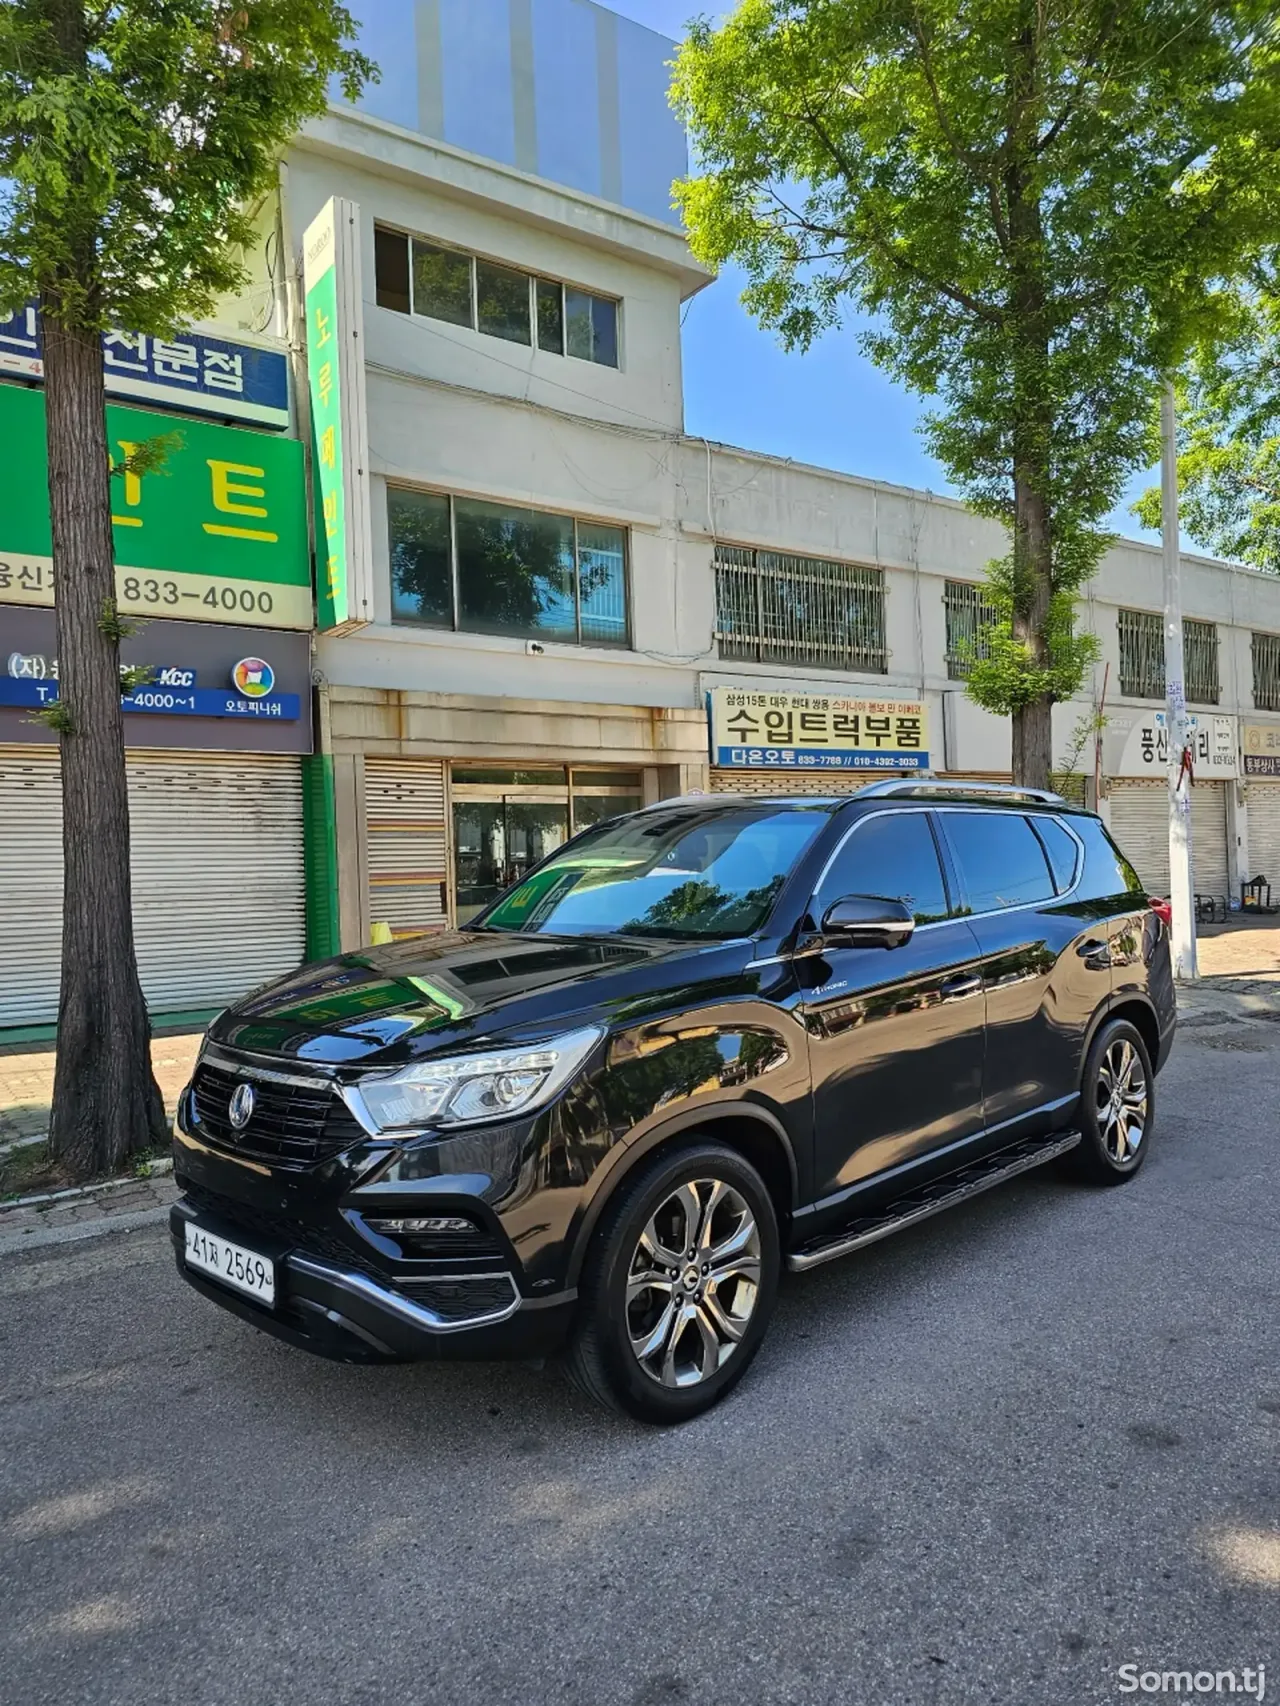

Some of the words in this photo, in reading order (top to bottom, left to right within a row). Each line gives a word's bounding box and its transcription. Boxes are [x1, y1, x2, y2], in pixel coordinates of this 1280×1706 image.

[103, 327, 244, 393] 전문점
[315, 307, 341, 600] 노루페인트
[123, 577, 274, 614] 833-4000
[159, 667, 193, 687] KCC
[225, 699, 281, 716] 오토피니쉬
[770, 696, 788, 708] 대우
[792, 697, 809, 709] 현대
[832, 700, 866, 712] 스카니아
[726, 709, 921, 748] 수입트럭부품
[225, 1247, 265, 1289] 2569
